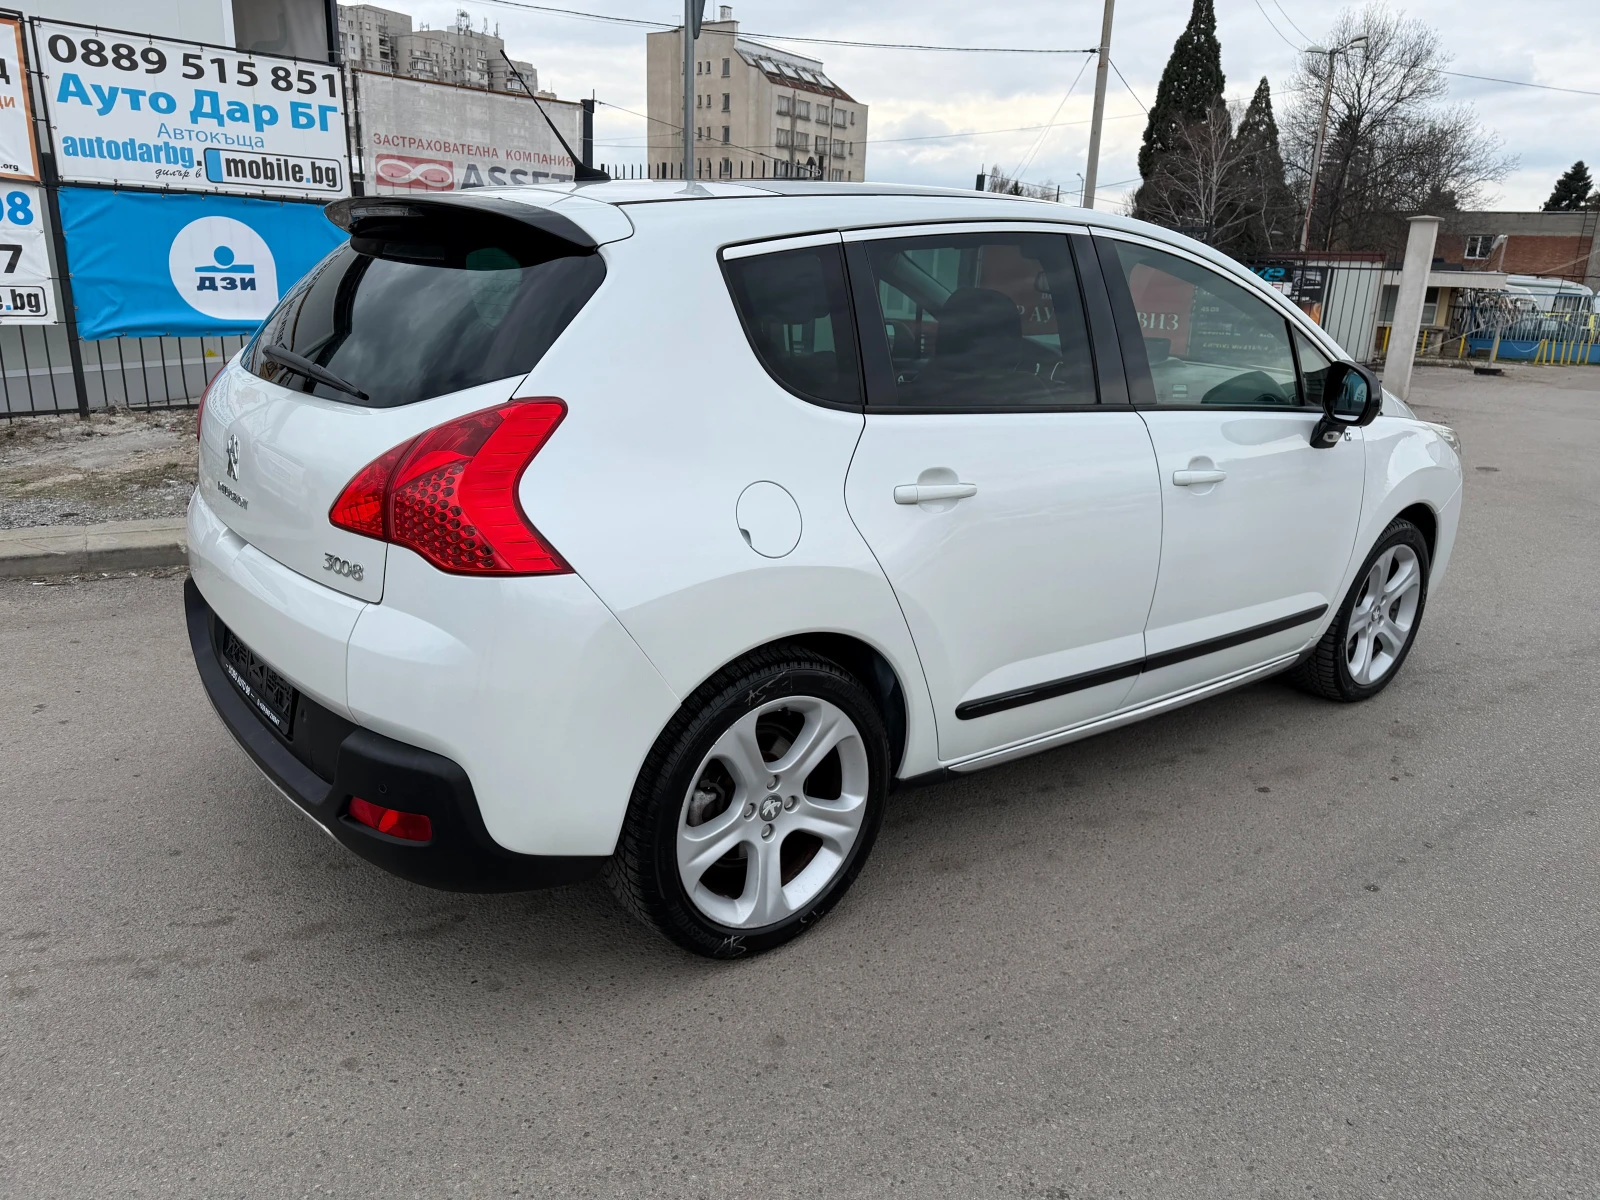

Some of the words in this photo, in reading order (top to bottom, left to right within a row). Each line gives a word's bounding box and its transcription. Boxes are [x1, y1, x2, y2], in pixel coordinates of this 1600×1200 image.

[48, 34, 167, 74] 0889
[181, 53, 258, 87] 515
[271, 66, 337, 98] 851
[56, 72, 177, 116] Ауто
[189, 88, 279, 133] Дар
[289, 100, 338, 132] БГ
[156, 122, 265, 150] Автокъща
[373, 132, 499, 159] ЗАСТРАХОВАТЕЛНА
[505, 149, 574, 168] КОМПАНИЯ
[224, 156, 338, 188] mobile.bg
[0, 190, 34, 226] 8
[322, 552, 364, 582] 3008
